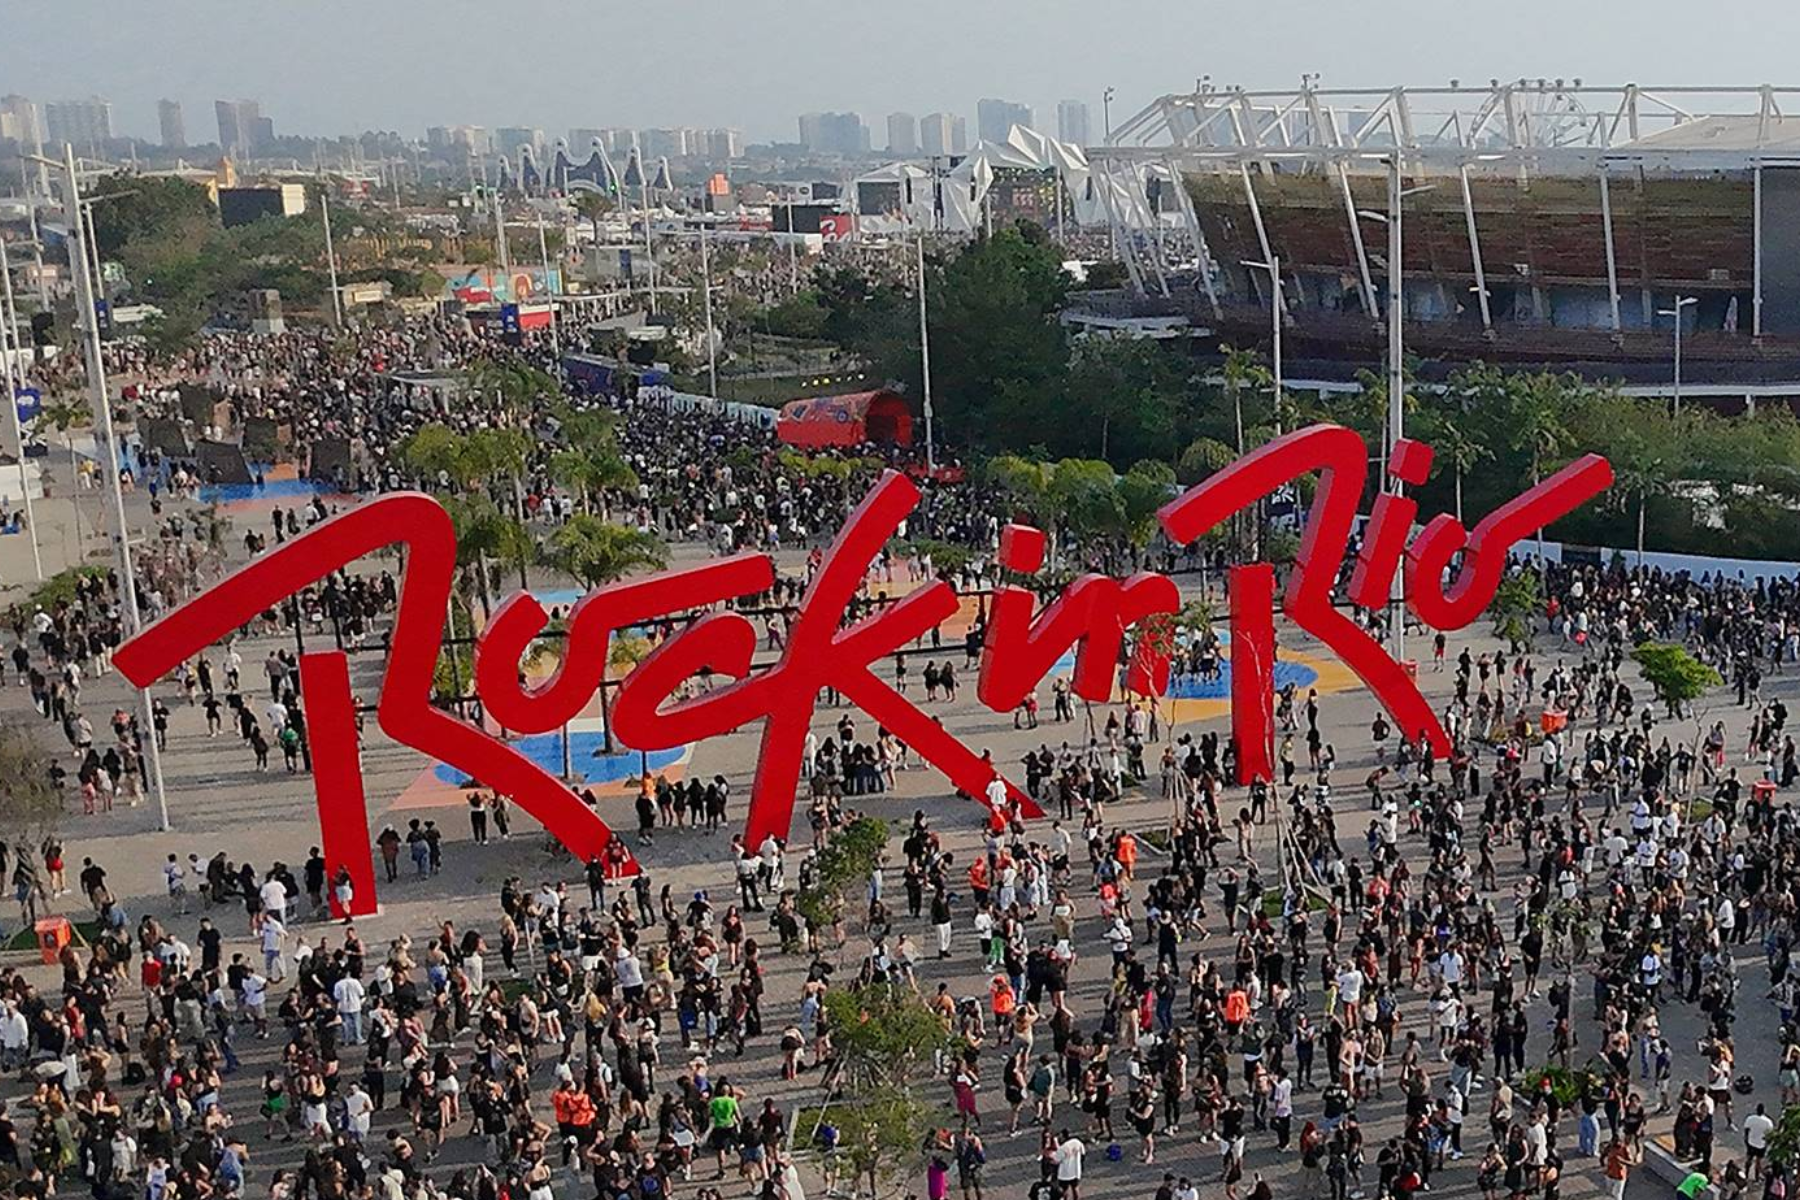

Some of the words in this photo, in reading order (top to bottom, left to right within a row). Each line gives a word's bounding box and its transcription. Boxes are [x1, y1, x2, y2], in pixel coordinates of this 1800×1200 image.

[112, 470, 1044, 919] Rock
[978, 524, 1182, 713] in
[1157, 423, 1615, 787] Rio
